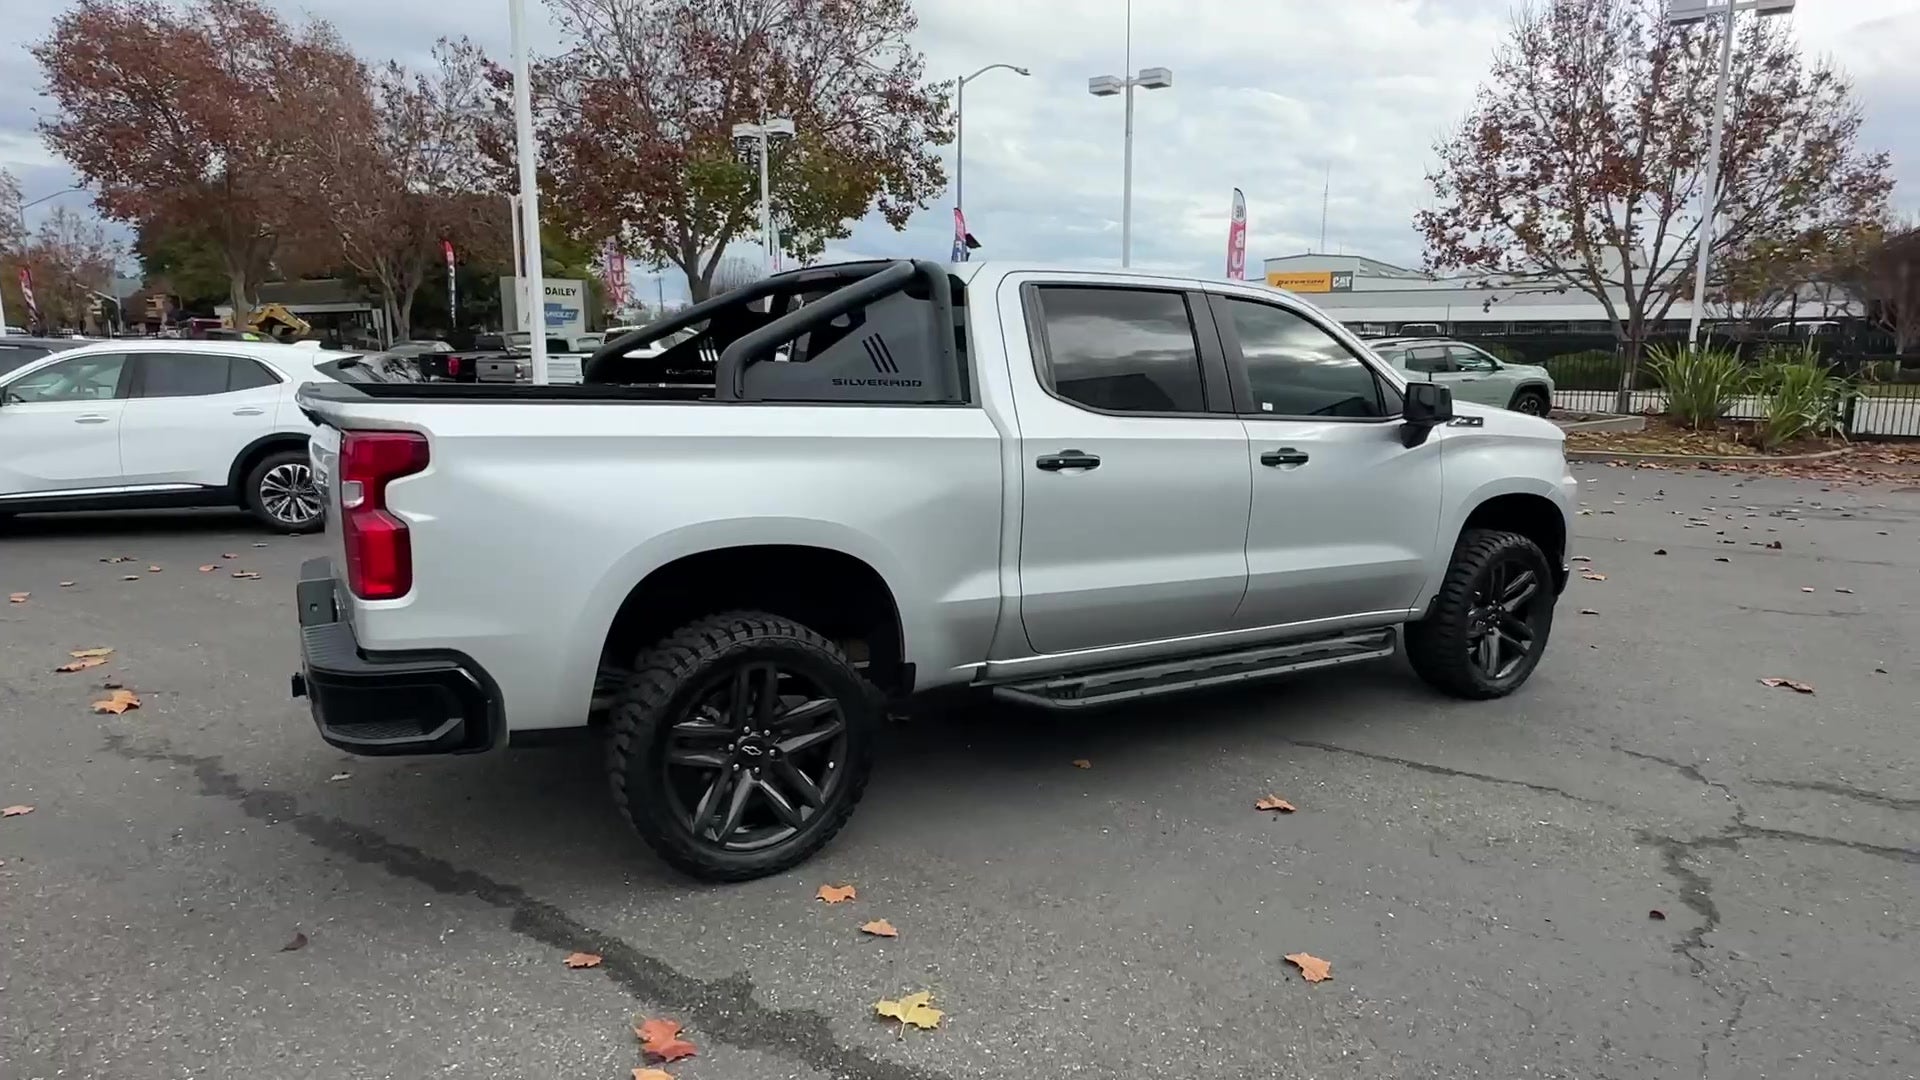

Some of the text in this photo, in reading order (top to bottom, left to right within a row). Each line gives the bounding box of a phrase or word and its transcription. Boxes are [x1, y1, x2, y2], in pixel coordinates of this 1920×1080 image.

[1332, 276, 1352, 288] CAT
[545, 287, 577, 296] DAILEY
[832, 378, 922, 387] SILVERADO
